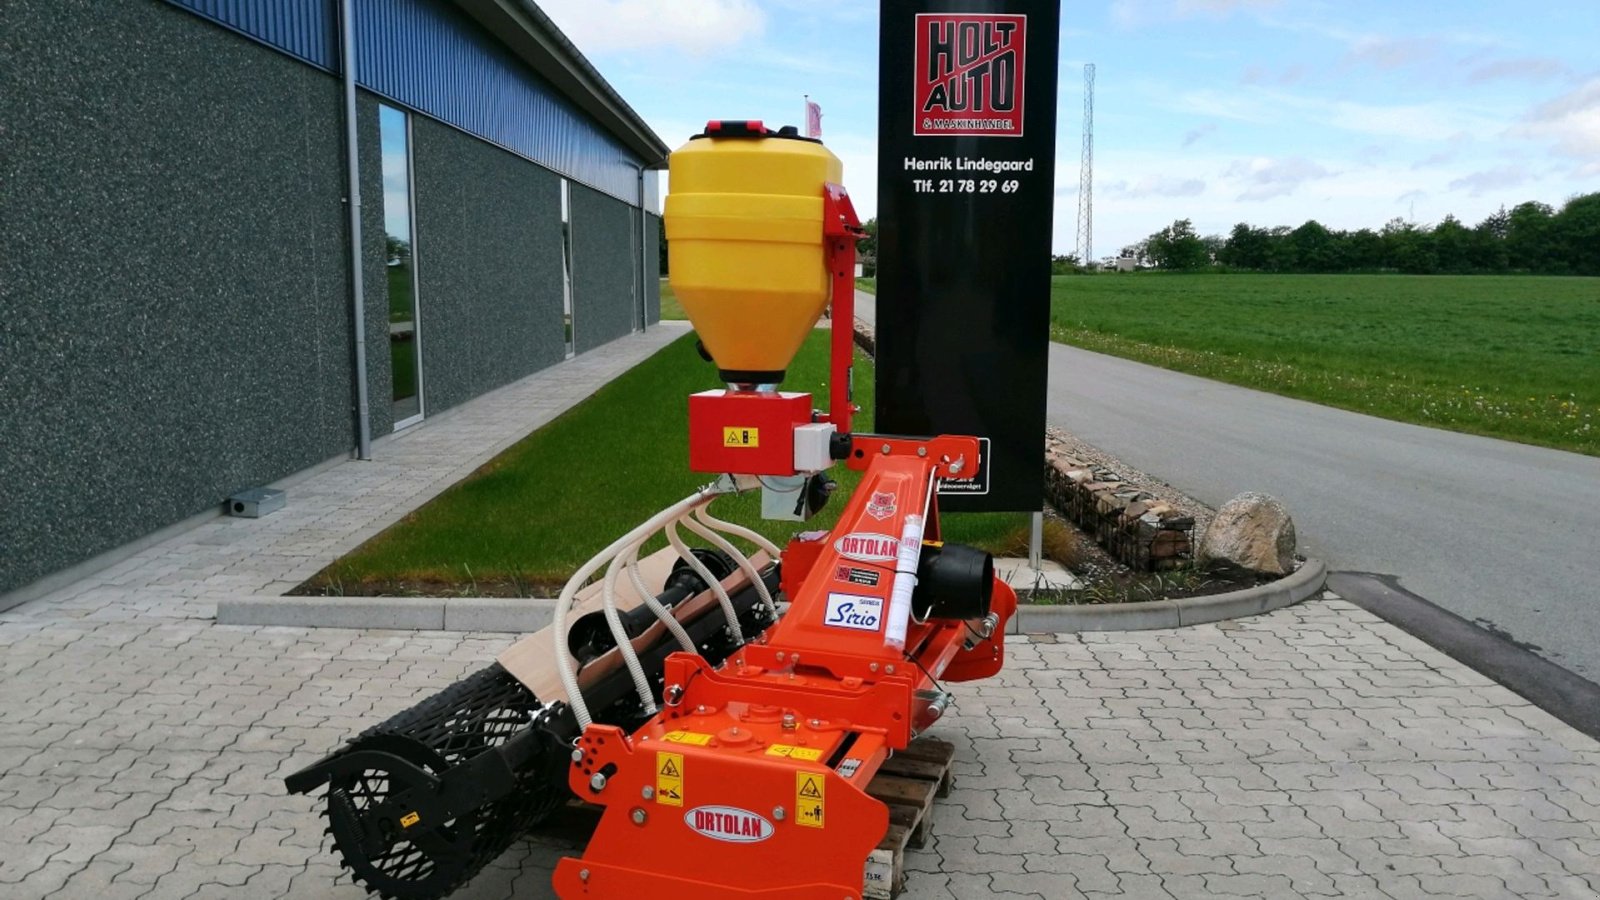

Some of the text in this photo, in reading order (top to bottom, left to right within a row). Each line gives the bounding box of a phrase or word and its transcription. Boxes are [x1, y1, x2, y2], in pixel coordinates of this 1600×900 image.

[928, 20, 1017, 84] HOLT
[922, 49, 1016, 112] AUTO
[923, 118, 1014, 130] & MASKINHANDEL
[904, 157, 1034, 173] Henrik Lindegaard
[913, 180, 1019, 193] Tlf. 21 78 29 69
[841, 536, 898, 558] ORTOLAN
[828, 602, 877, 626] Sirio
[694, 810, 762, 837] ORTOLAN
